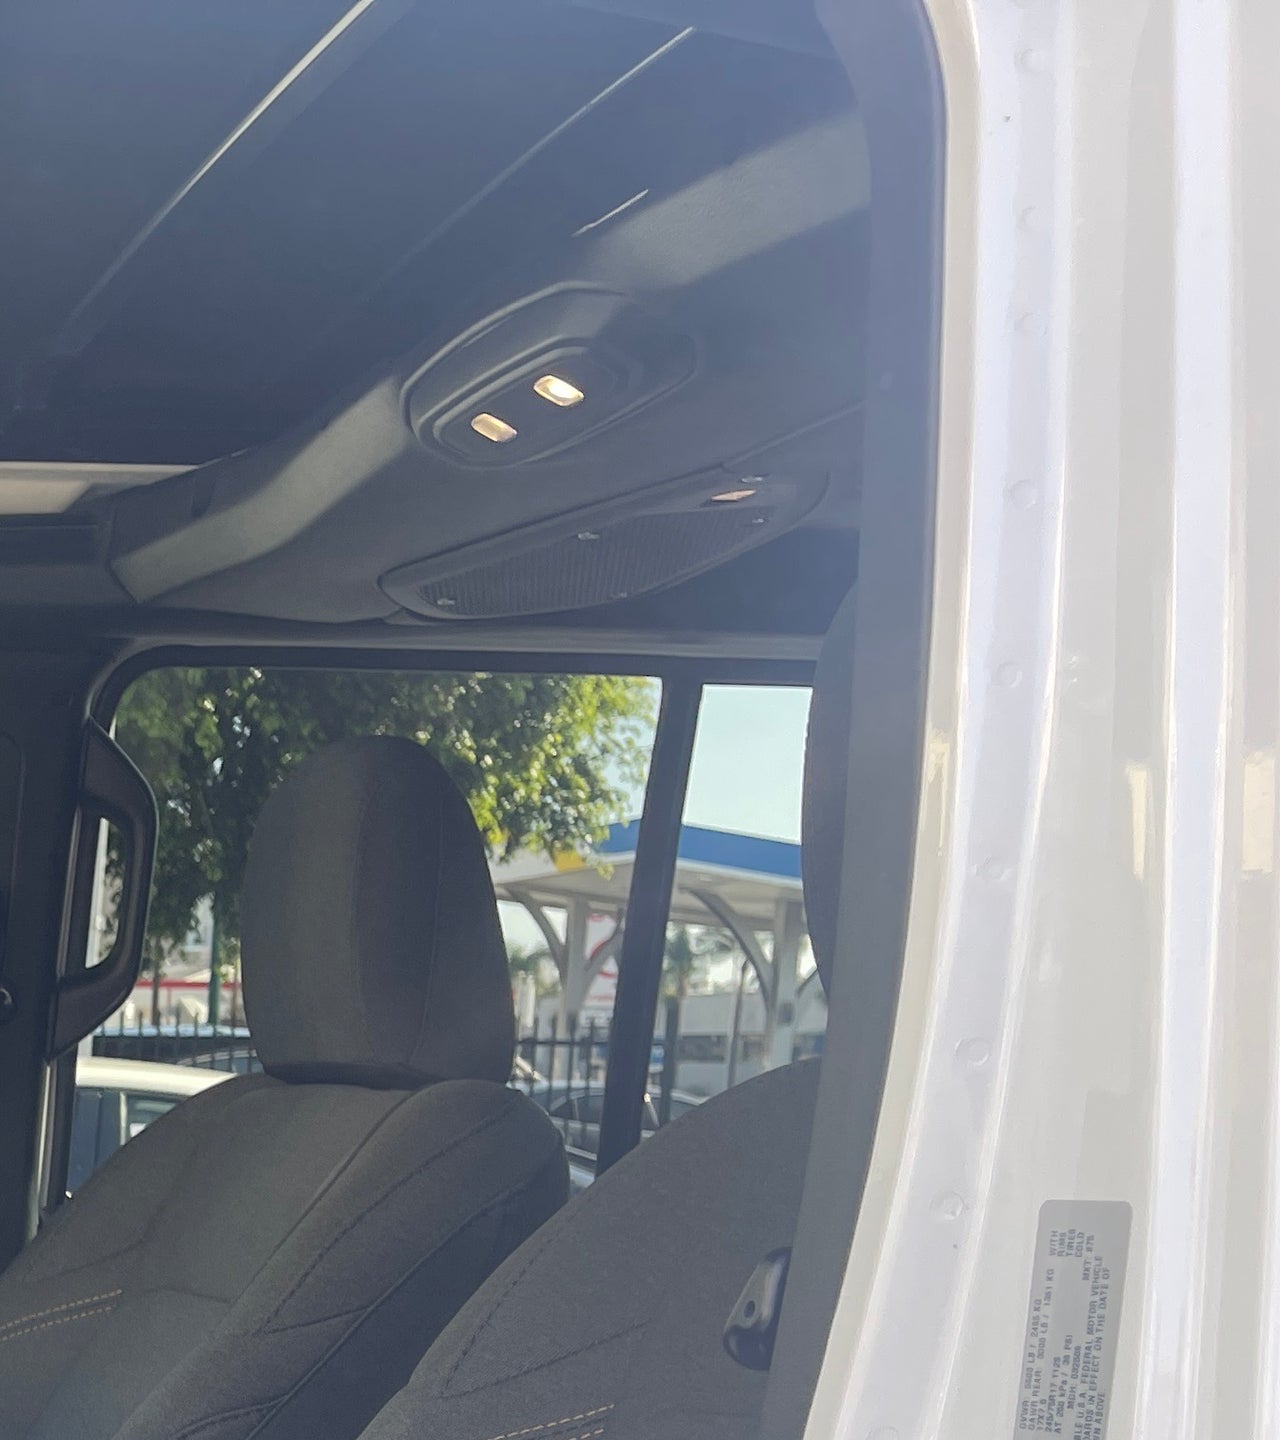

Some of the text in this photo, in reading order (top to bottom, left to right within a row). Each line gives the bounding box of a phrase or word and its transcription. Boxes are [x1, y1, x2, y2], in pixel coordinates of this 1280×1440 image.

[1048, 1230, 1059, 1255] WITH
[1090, 1255, 1103, 1296] VEHICLE
[1097, 1283, 1109, 1309] DATE
[1085, 1300, 1097, 1334] MOTOR
[1095, 1313, 1105, 1333] THE
[1079, 1337, 1093, 1383] FEDERAL
[1088, 1355, 1100, 1391] EFFECT
